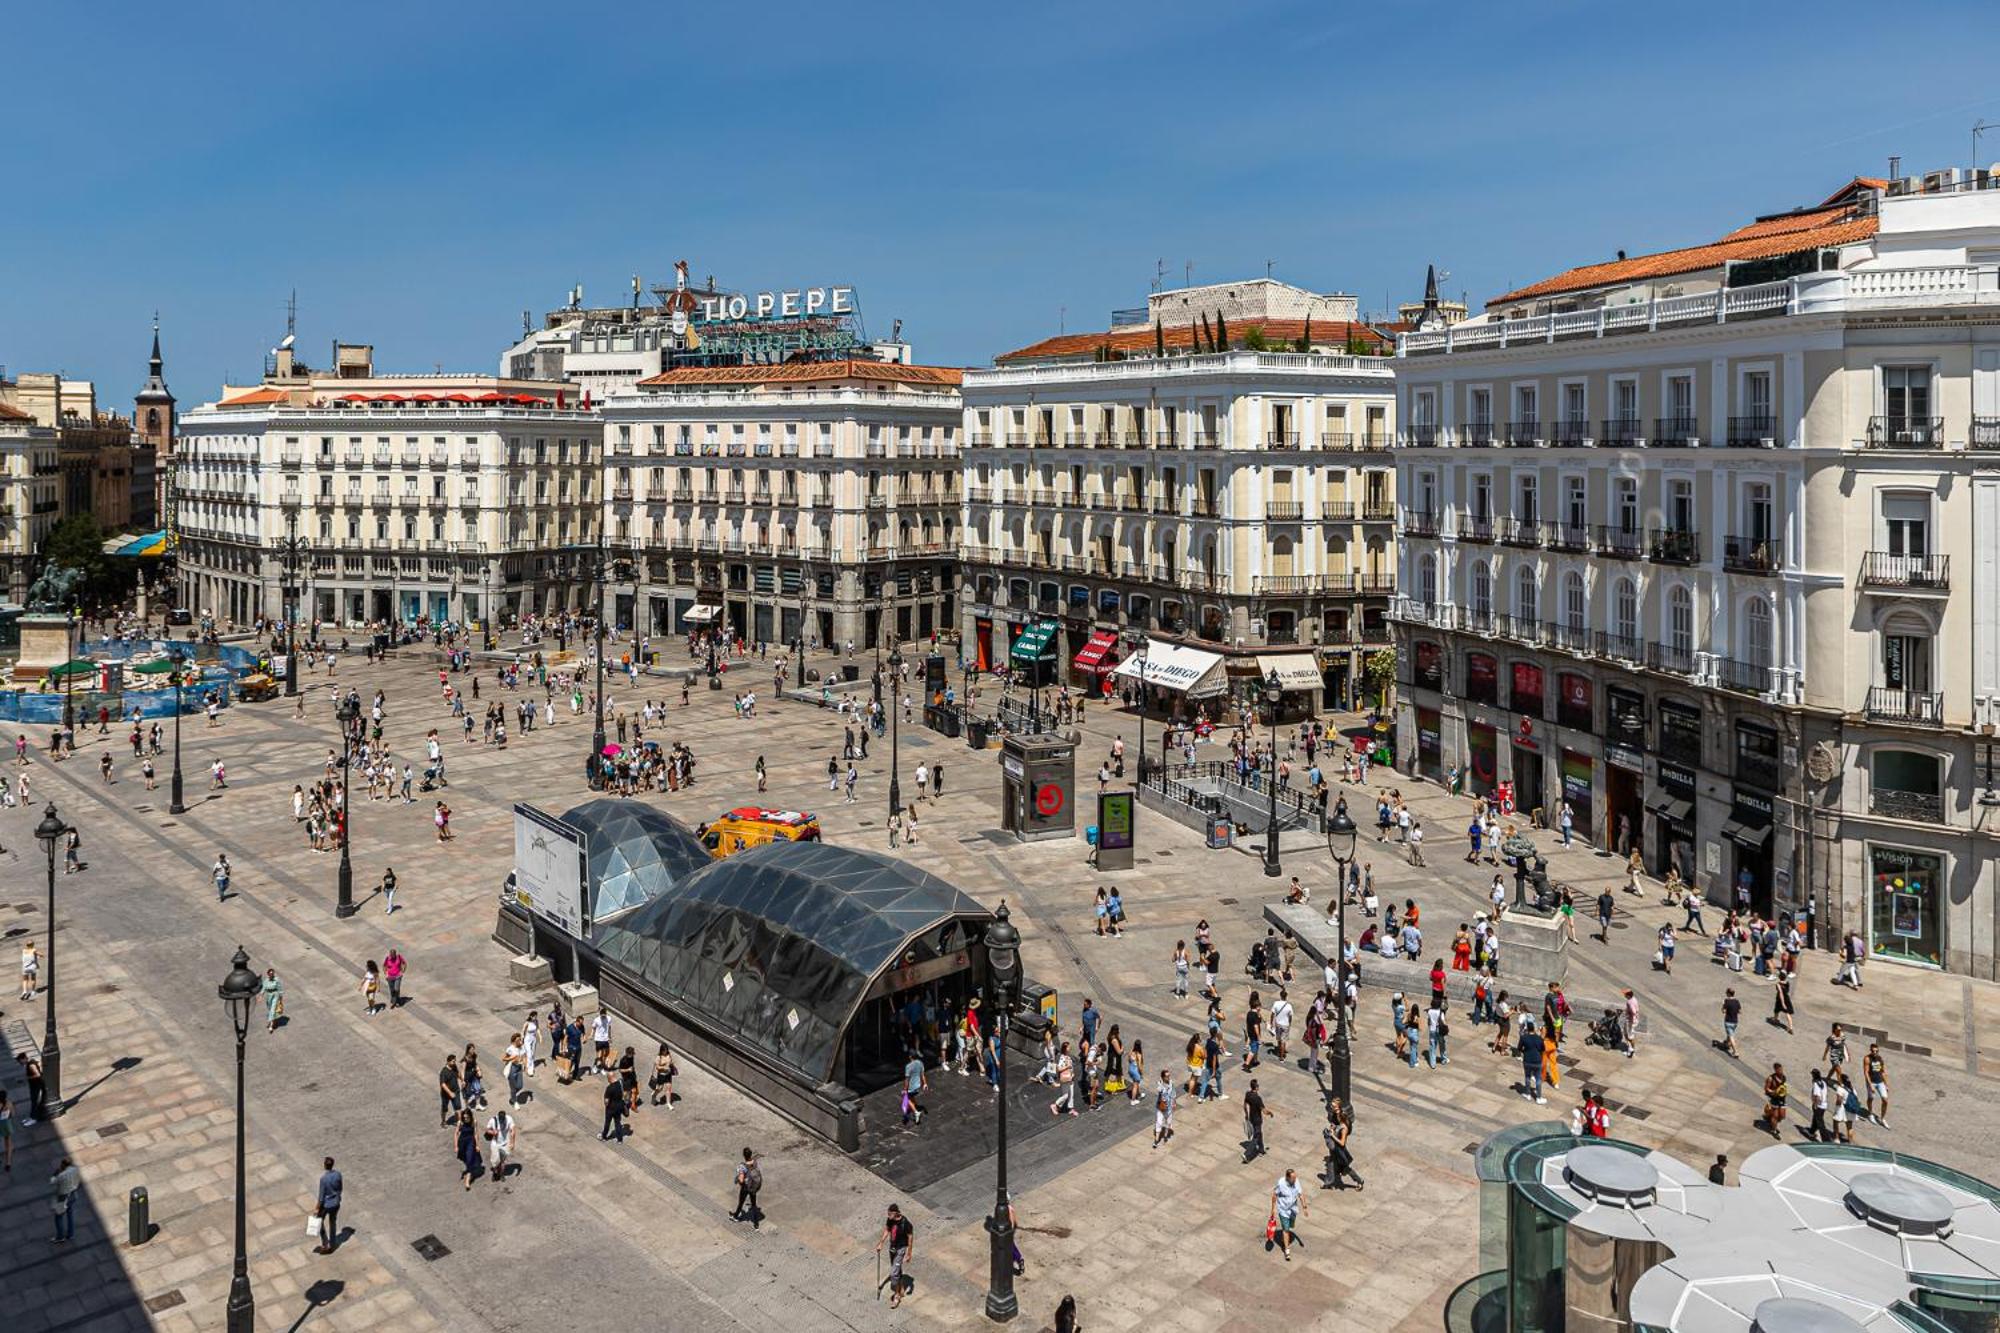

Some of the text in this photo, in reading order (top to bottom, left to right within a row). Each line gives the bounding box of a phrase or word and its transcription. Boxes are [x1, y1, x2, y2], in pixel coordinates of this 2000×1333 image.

[701, 287, 852, 321] TIO PEPE
[1163, 664, 1200, 679] DIEGO
[1292, 670, 1319, 678] DIEGO
